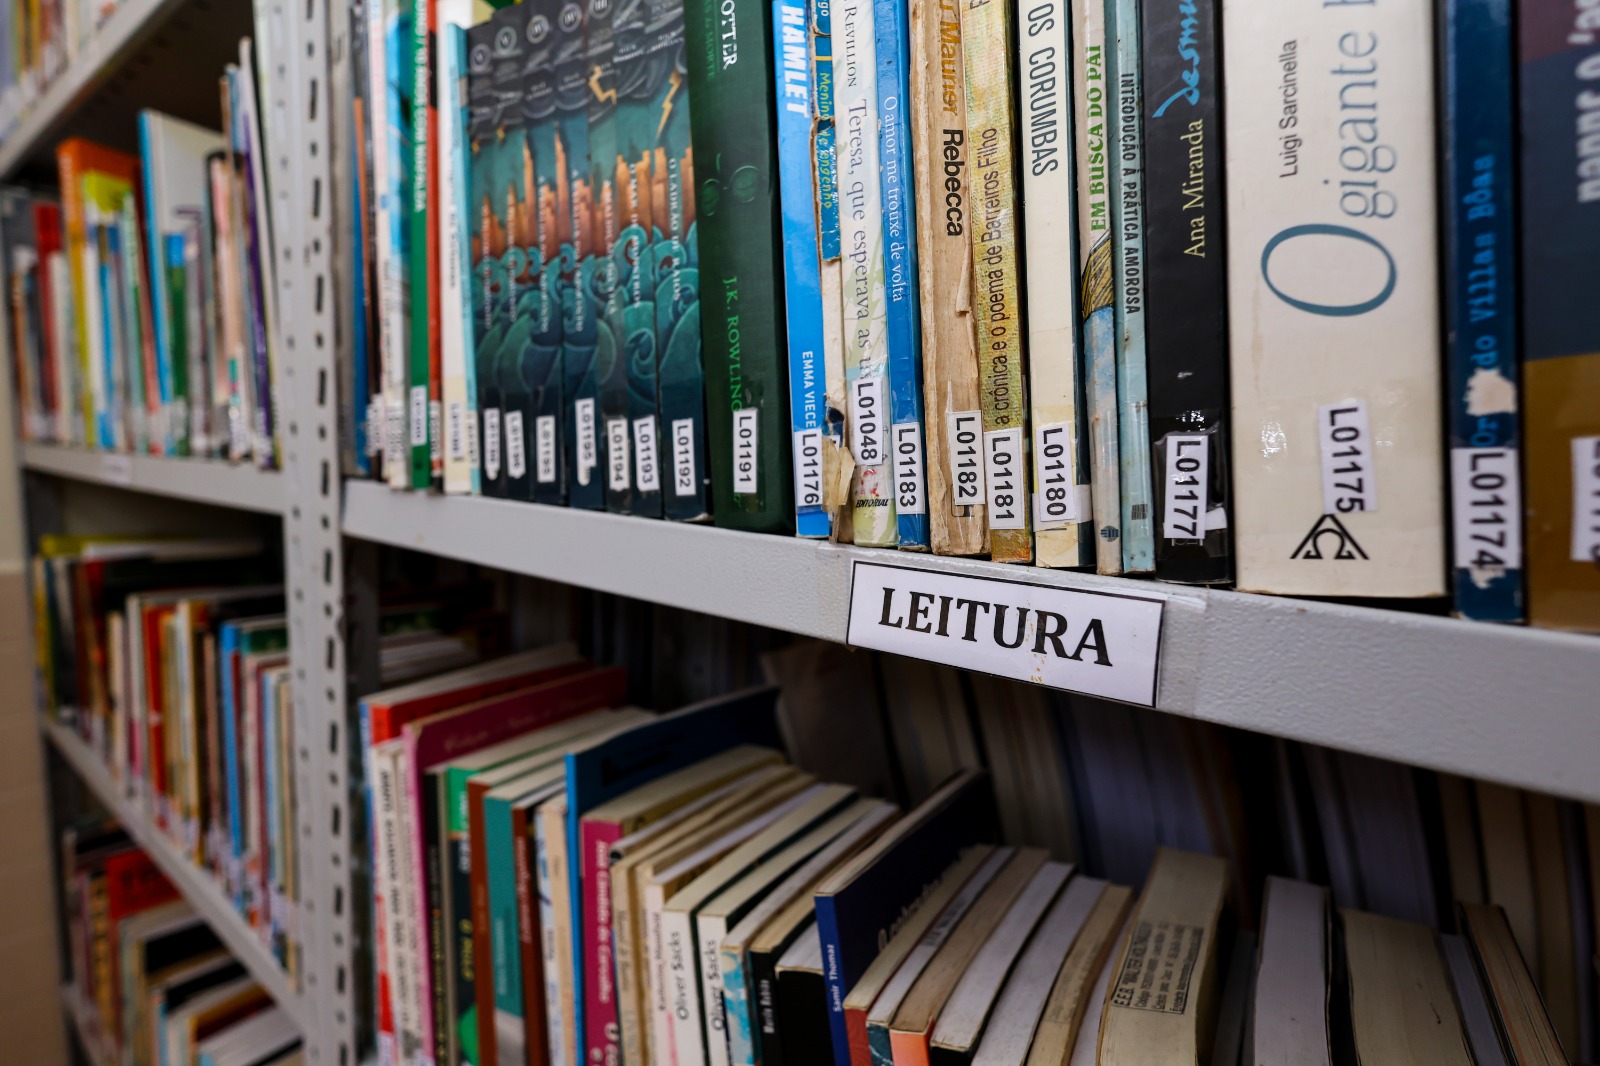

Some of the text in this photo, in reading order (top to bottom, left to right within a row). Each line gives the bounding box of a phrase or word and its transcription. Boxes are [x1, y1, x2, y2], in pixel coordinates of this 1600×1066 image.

[781, 5, 809, 118] HAMLET
[844, 7, 858, 87] REVILLION
[938, 19, 960, 117] Maurier
[1027, 3, 1059, 177] OS CORUMBAS
[819, 72, 832, 121] Menino
[847, 99, 868, 177] Teresa,
[1085, 45, 1107, 231] EM BUSCA DO PAI
[1278, 39, 1304, 179] Luigi Sarcinella
[1322, 31, 1399, 219] gigante
[668, 157, 677, 169] O
[669, 174, 681, 231] LADRÃO
[820, 147, 834, 209] engenho
[847, 180, 865, 221] que
[883, 96, 906, 303] O amor me trouxe de volta
[942, 128, 964, 237] Rebecca
[1121, 73, 1142, 315] INTRODUÇÃO À PRÁTICA AMOROSA
[1180, 118, 1206, 258] Ana Miranda
[849, 227, 870, 320] esperava
[977, 127, 1010, 425] a crônica e o poema de Barreiros Filho
[1261, 223, 1398, 317] O
[1463, 154, 1498, 447] Ordo Villas Bôas
[723, 276, 743, 412] J.K. ROWLING
[802, 350, 814, 388] EMMA
[857, 328, 871, 349] as
[611, 423, 625, 483] L01194
[637, 422, 655, 484] L01193
[676, 423, 692, 488] L01192
[738, 415, 753, 484] L01191
[857, 382, 878, 461] L01048
[955, 416, 978, 498] L01182
[1329, 406, 1365, 513] L01175
[801, 432, 820, 505] L01176
[897, 427, 918, 508] L01183
[992, 435, 1014, 521] L01181
[1042, 428, 1068, 516] L01180
[1172, 440, 1202, 536] L01177
[1469, 451, 1507, 568] L01174
[878, 586, 1114, 667] LEITURA
[668, 930, 690, 1021] Oliver Sacks
[703, 938, 725, 1032] Oliver Sacks
[826, 943, 843, 1013] Samir Thomaz
